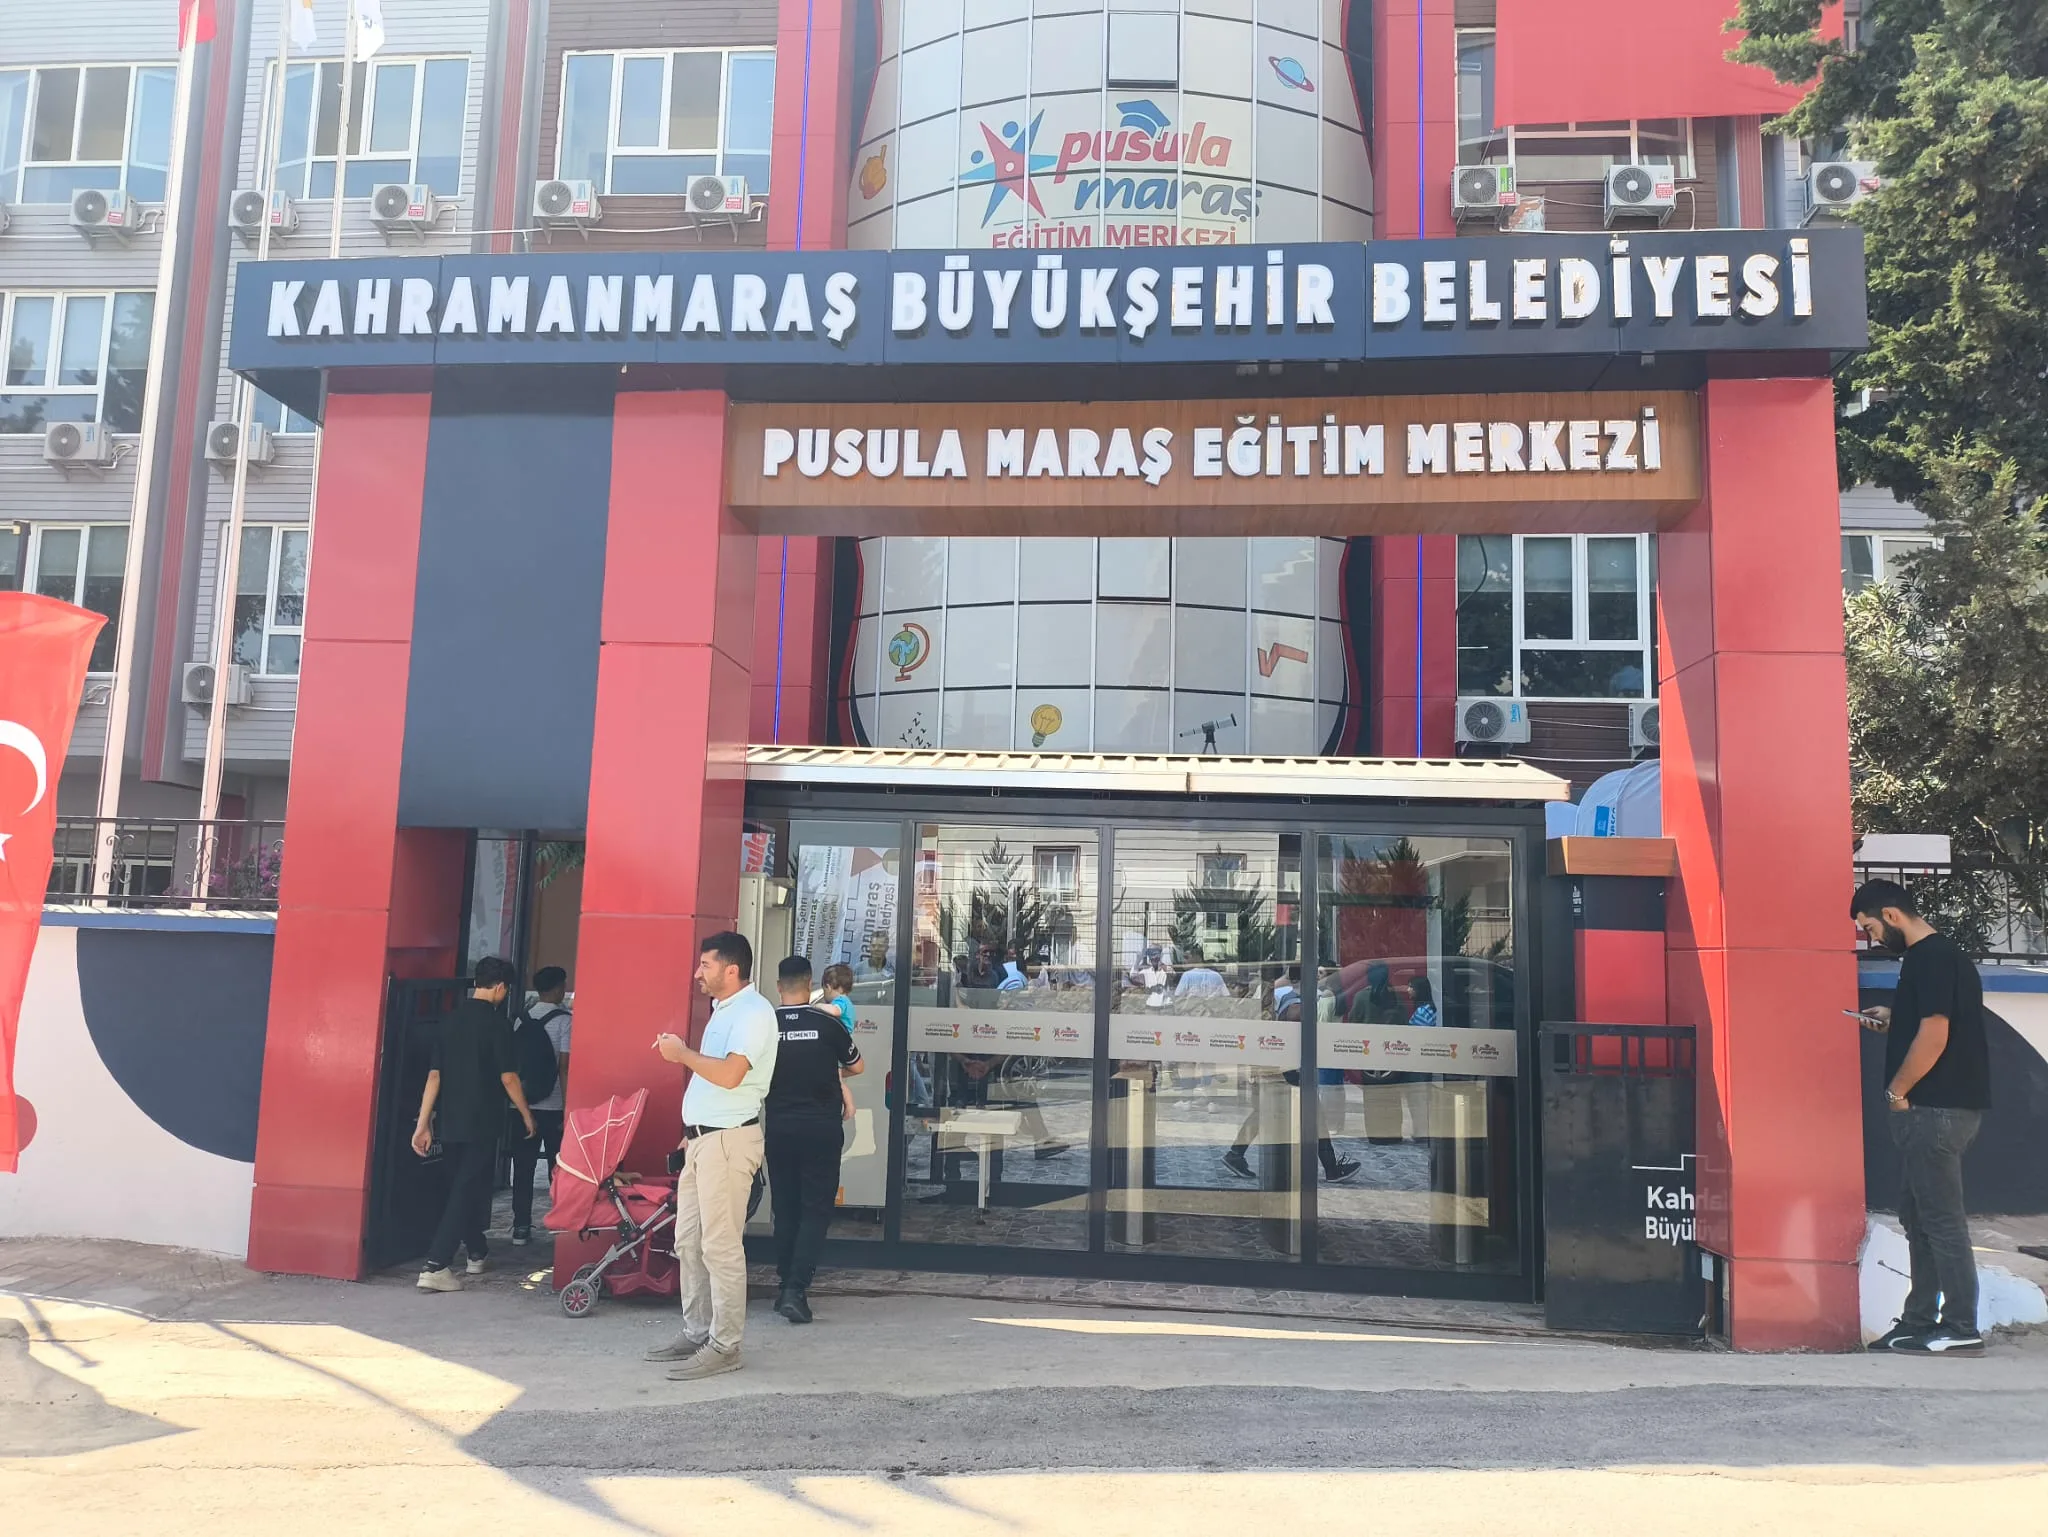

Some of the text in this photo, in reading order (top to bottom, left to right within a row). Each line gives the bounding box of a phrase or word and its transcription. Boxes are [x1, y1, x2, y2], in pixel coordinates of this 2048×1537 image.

[1054, 121, 1232, 184] pusula
[1074, 177, 1262, 222] maraş
[992, 221, 1237, 248] EĞİTİM MERKEZİ
[267, 238, 1812, 341] KAHRAMANMARAŞ BÜYÜKŞEHİR BELEDİYESİ
[763, 406, 1660, 485] PUSULA MARAŞ EĞİTİM MERKEZİ
